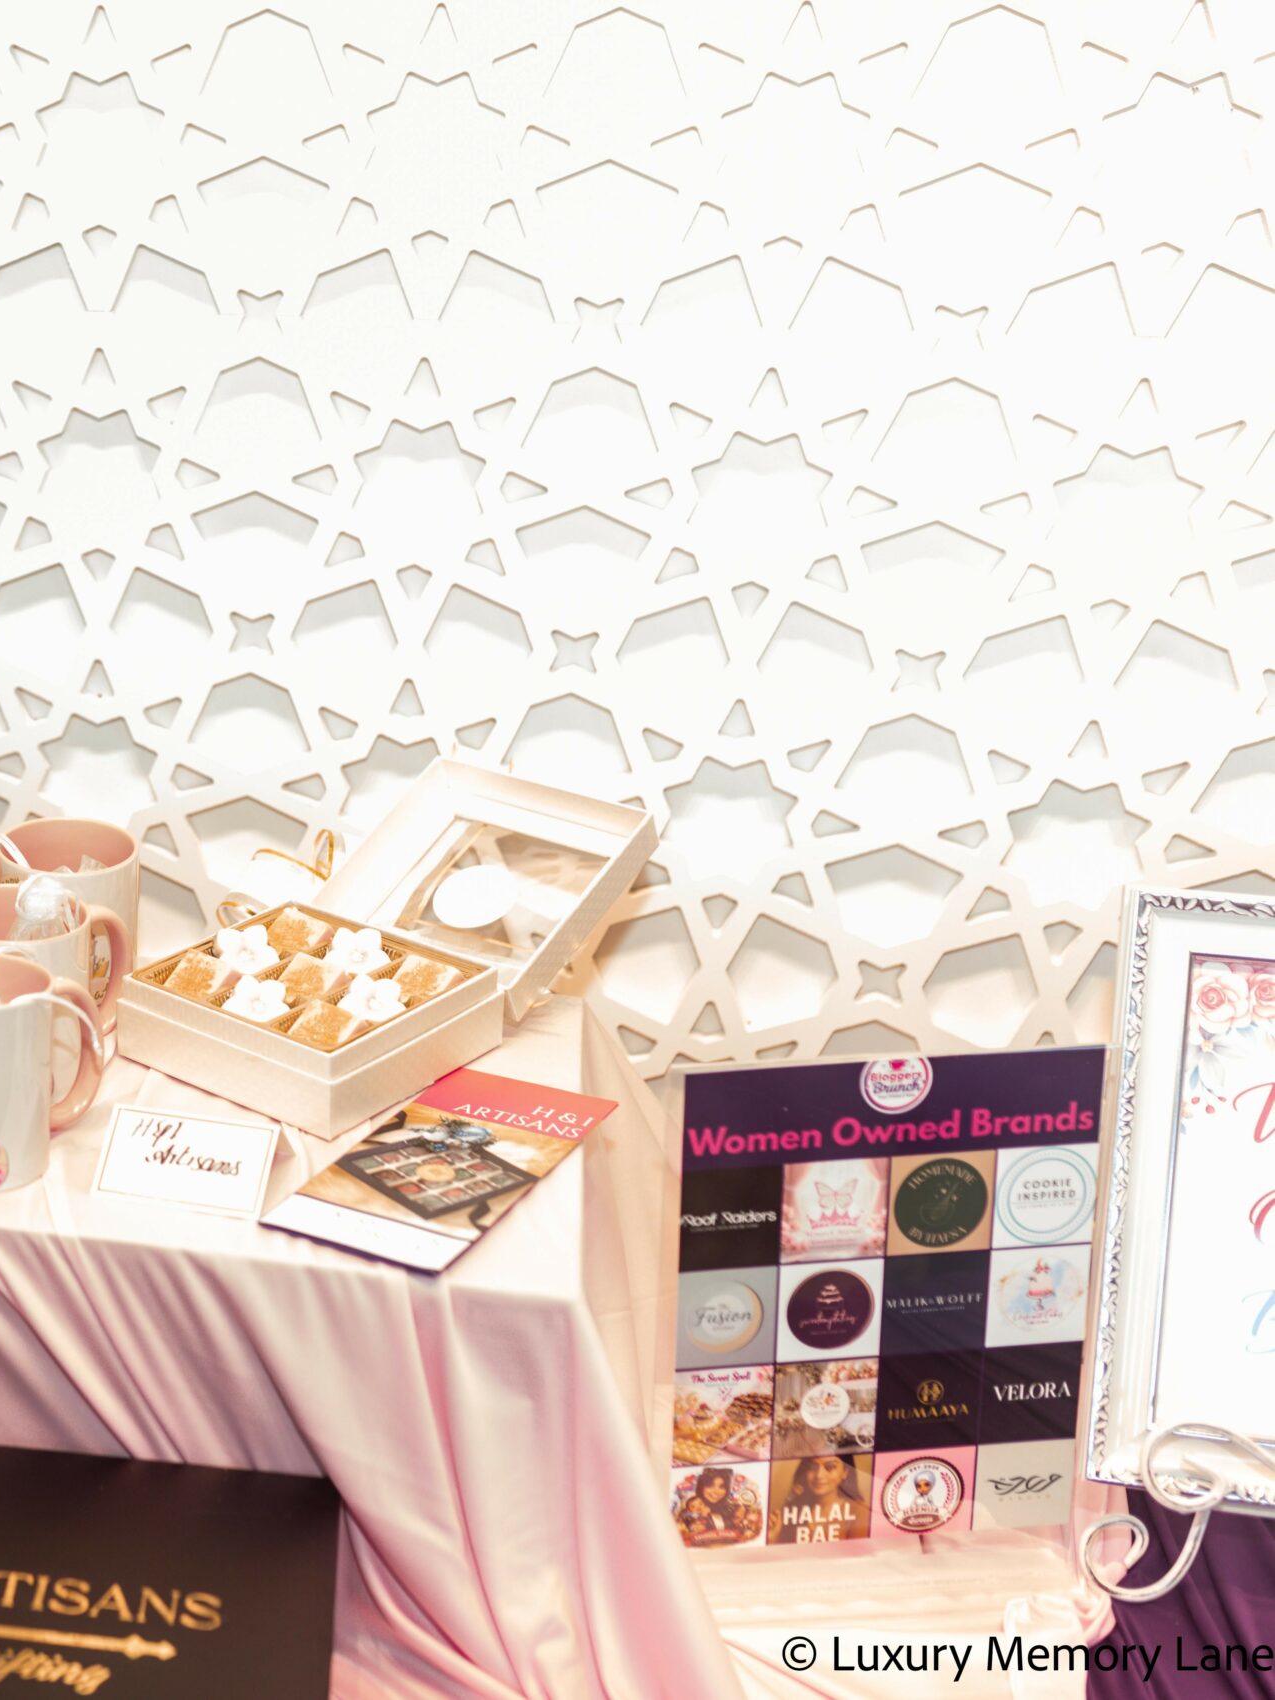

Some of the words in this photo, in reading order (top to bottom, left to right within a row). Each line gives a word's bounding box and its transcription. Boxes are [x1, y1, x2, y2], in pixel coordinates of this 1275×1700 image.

[873, 1079, 922, 1095] Brunch
[453, 1103, 583, 1139] ARTISANS
[532, 1105, 555, 1119] H
[558, 1112, 578, 1126] &
[582, 1116, 594, 1127] I
[688, 1127, 823, 1157] Women
[831, 1110, 961, 1148] Owned
[970, 1099, 1095, 1138] Brands
[1023, 1177, 1072, 1190] COOKIE
[1017, 1189, 1077, 1202] INSPIRED
[693, 1307, 752, 1327] Fusion
[993, 1381, 1071, 1402] VELORA
[783, 1502, 856, 1525] HALAL
[797, 1524, 841, 1544] BAE
